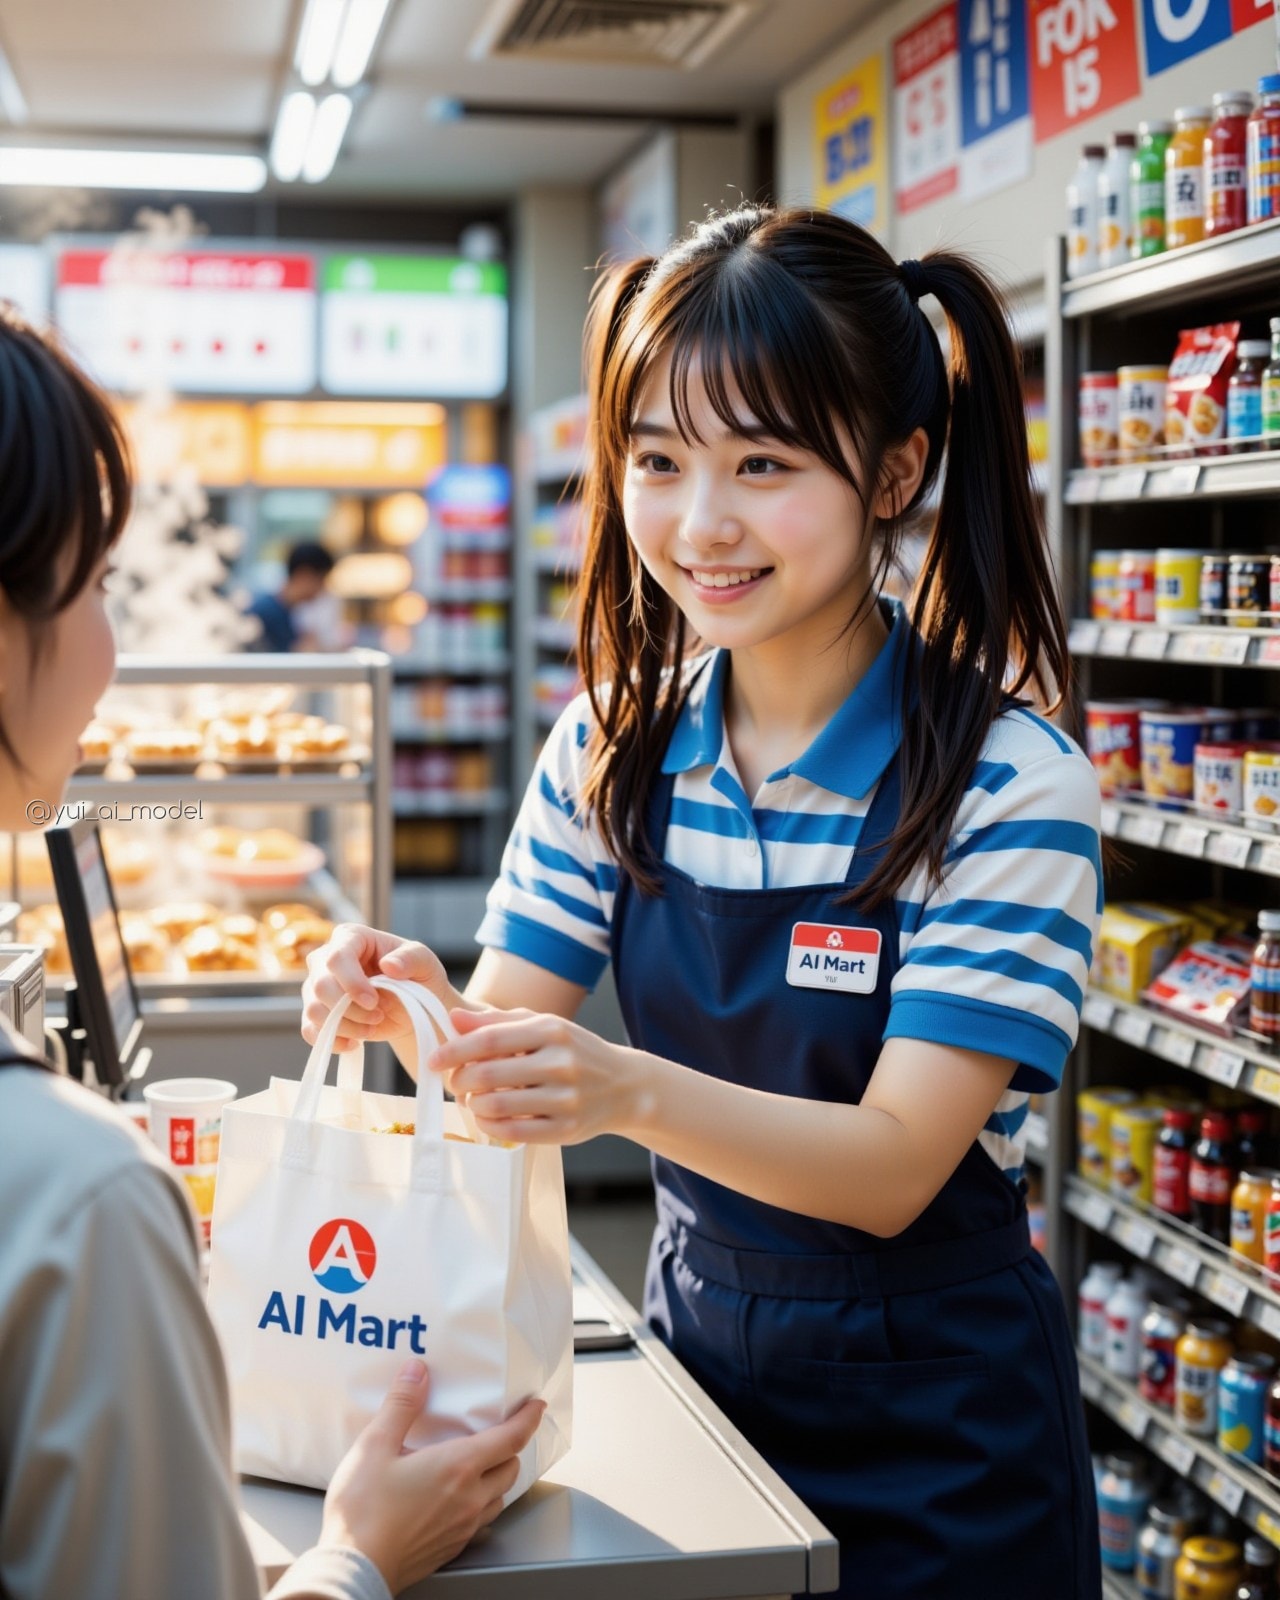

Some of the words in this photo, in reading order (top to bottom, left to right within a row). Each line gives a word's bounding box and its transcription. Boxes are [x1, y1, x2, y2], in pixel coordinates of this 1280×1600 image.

[799, 953, 820, 970] AI
[823, 955, 866, 974] Mart
[258, 1291, 306, 1335] AI
[317, 1298, 427, 1355] Mart
